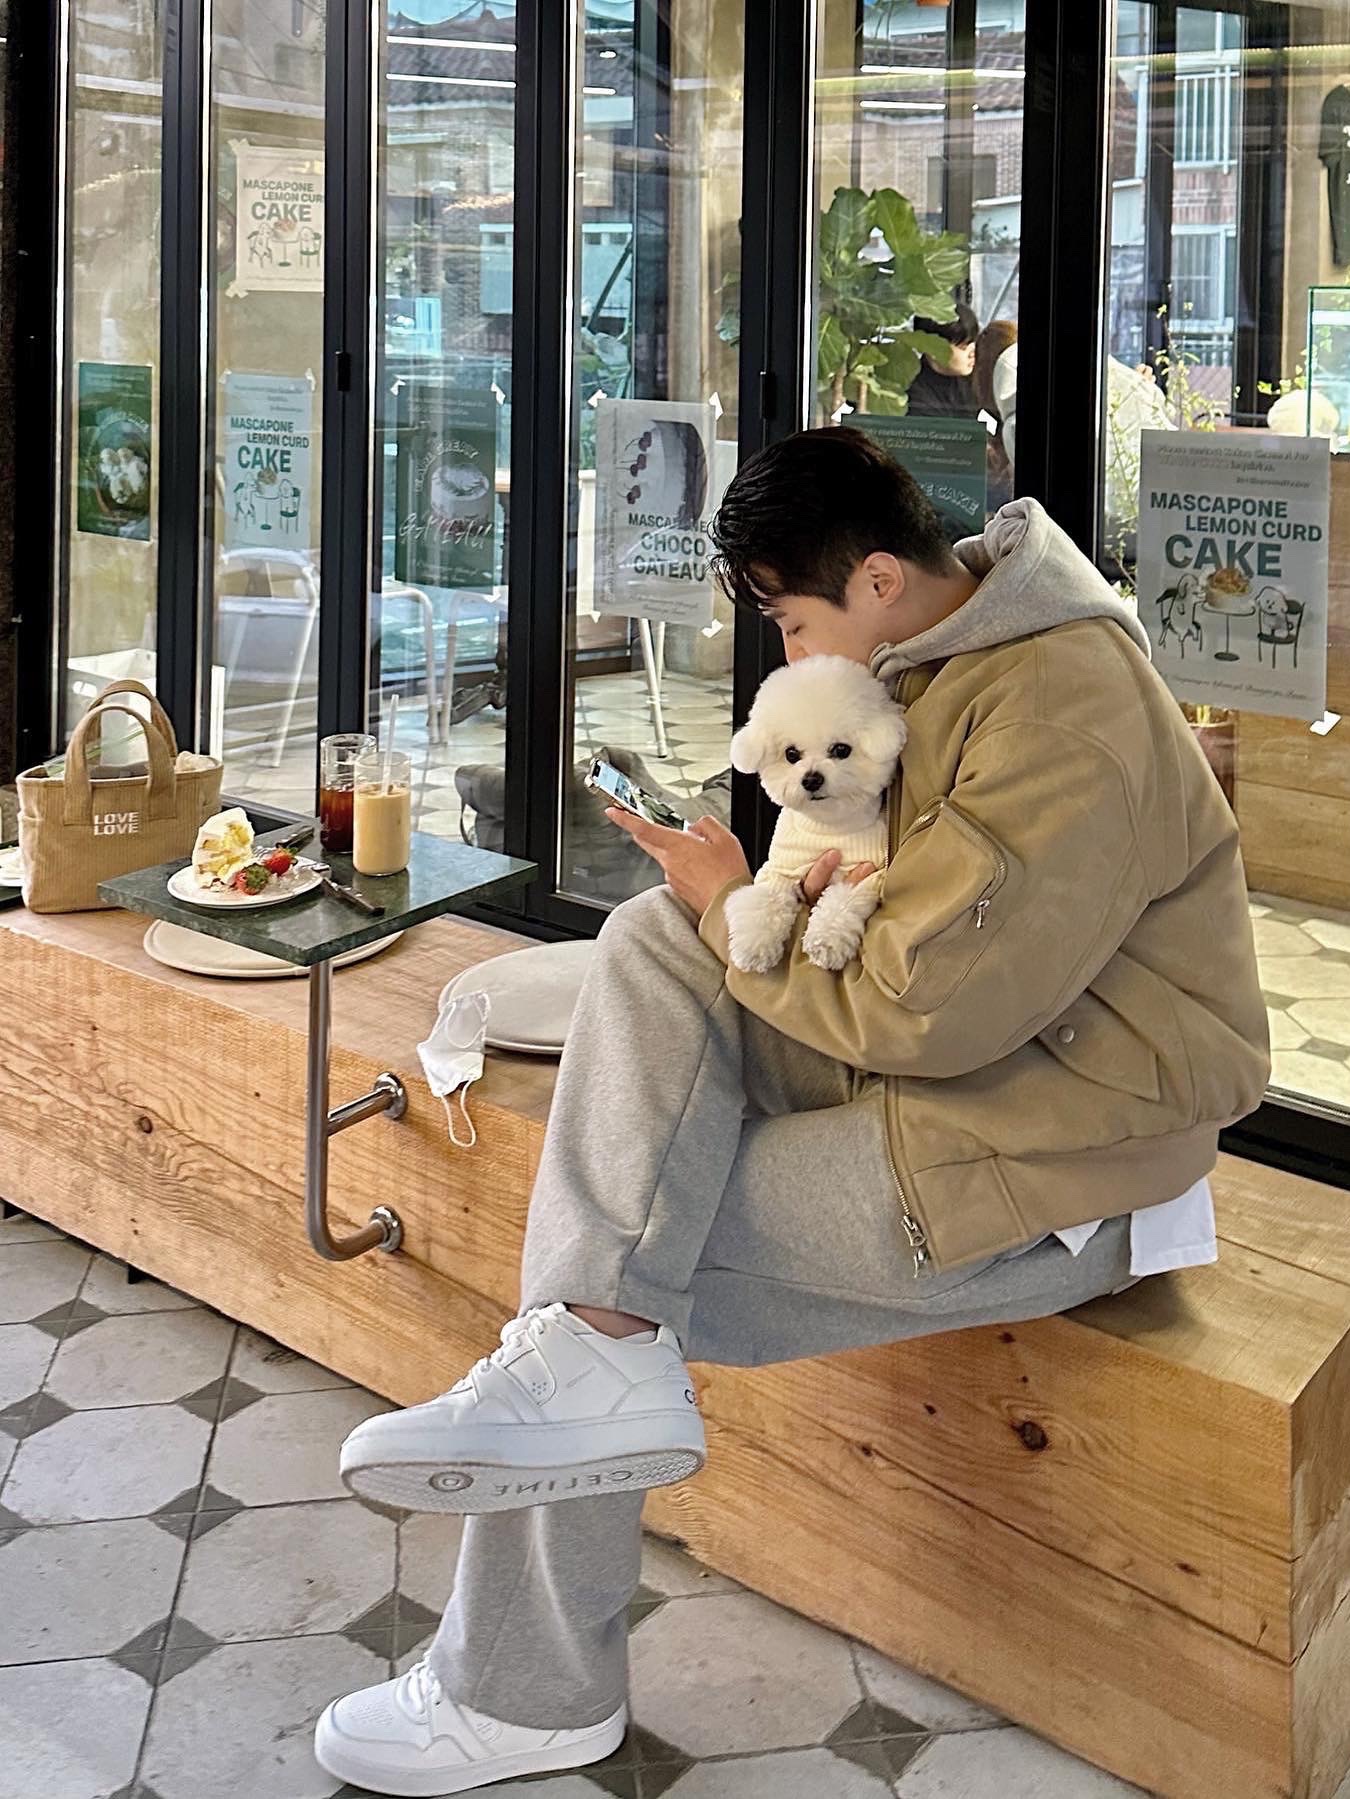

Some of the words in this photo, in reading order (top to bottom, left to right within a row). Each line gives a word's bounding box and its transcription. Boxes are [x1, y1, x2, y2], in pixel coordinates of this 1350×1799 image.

[243, 179, 313, 192] MASCAPONE
[262, 192, 299, 202] LEMON
[301, 193, 323, 204] CUR
[251, 202, 312, 222] CAKE
[231, 417, 294, 433] MASCAPONE
[247, 433, 280, 446] LEMON
[282, 435, 309, 448] CURD
[238, 445, 291, 473] CAKE
[1150, 491, 1287, 519] MASCAPONE
[1186, 515, 1256, 538] LEMON
[1262, 522, 1322, 542] CURD
[641, 532, 706, 557] CHOCO
[1165, 534, 1282, 579] CAKE
[94, 812, 140, 825] LOVE
[94, 822, 140, 835] LOVE
